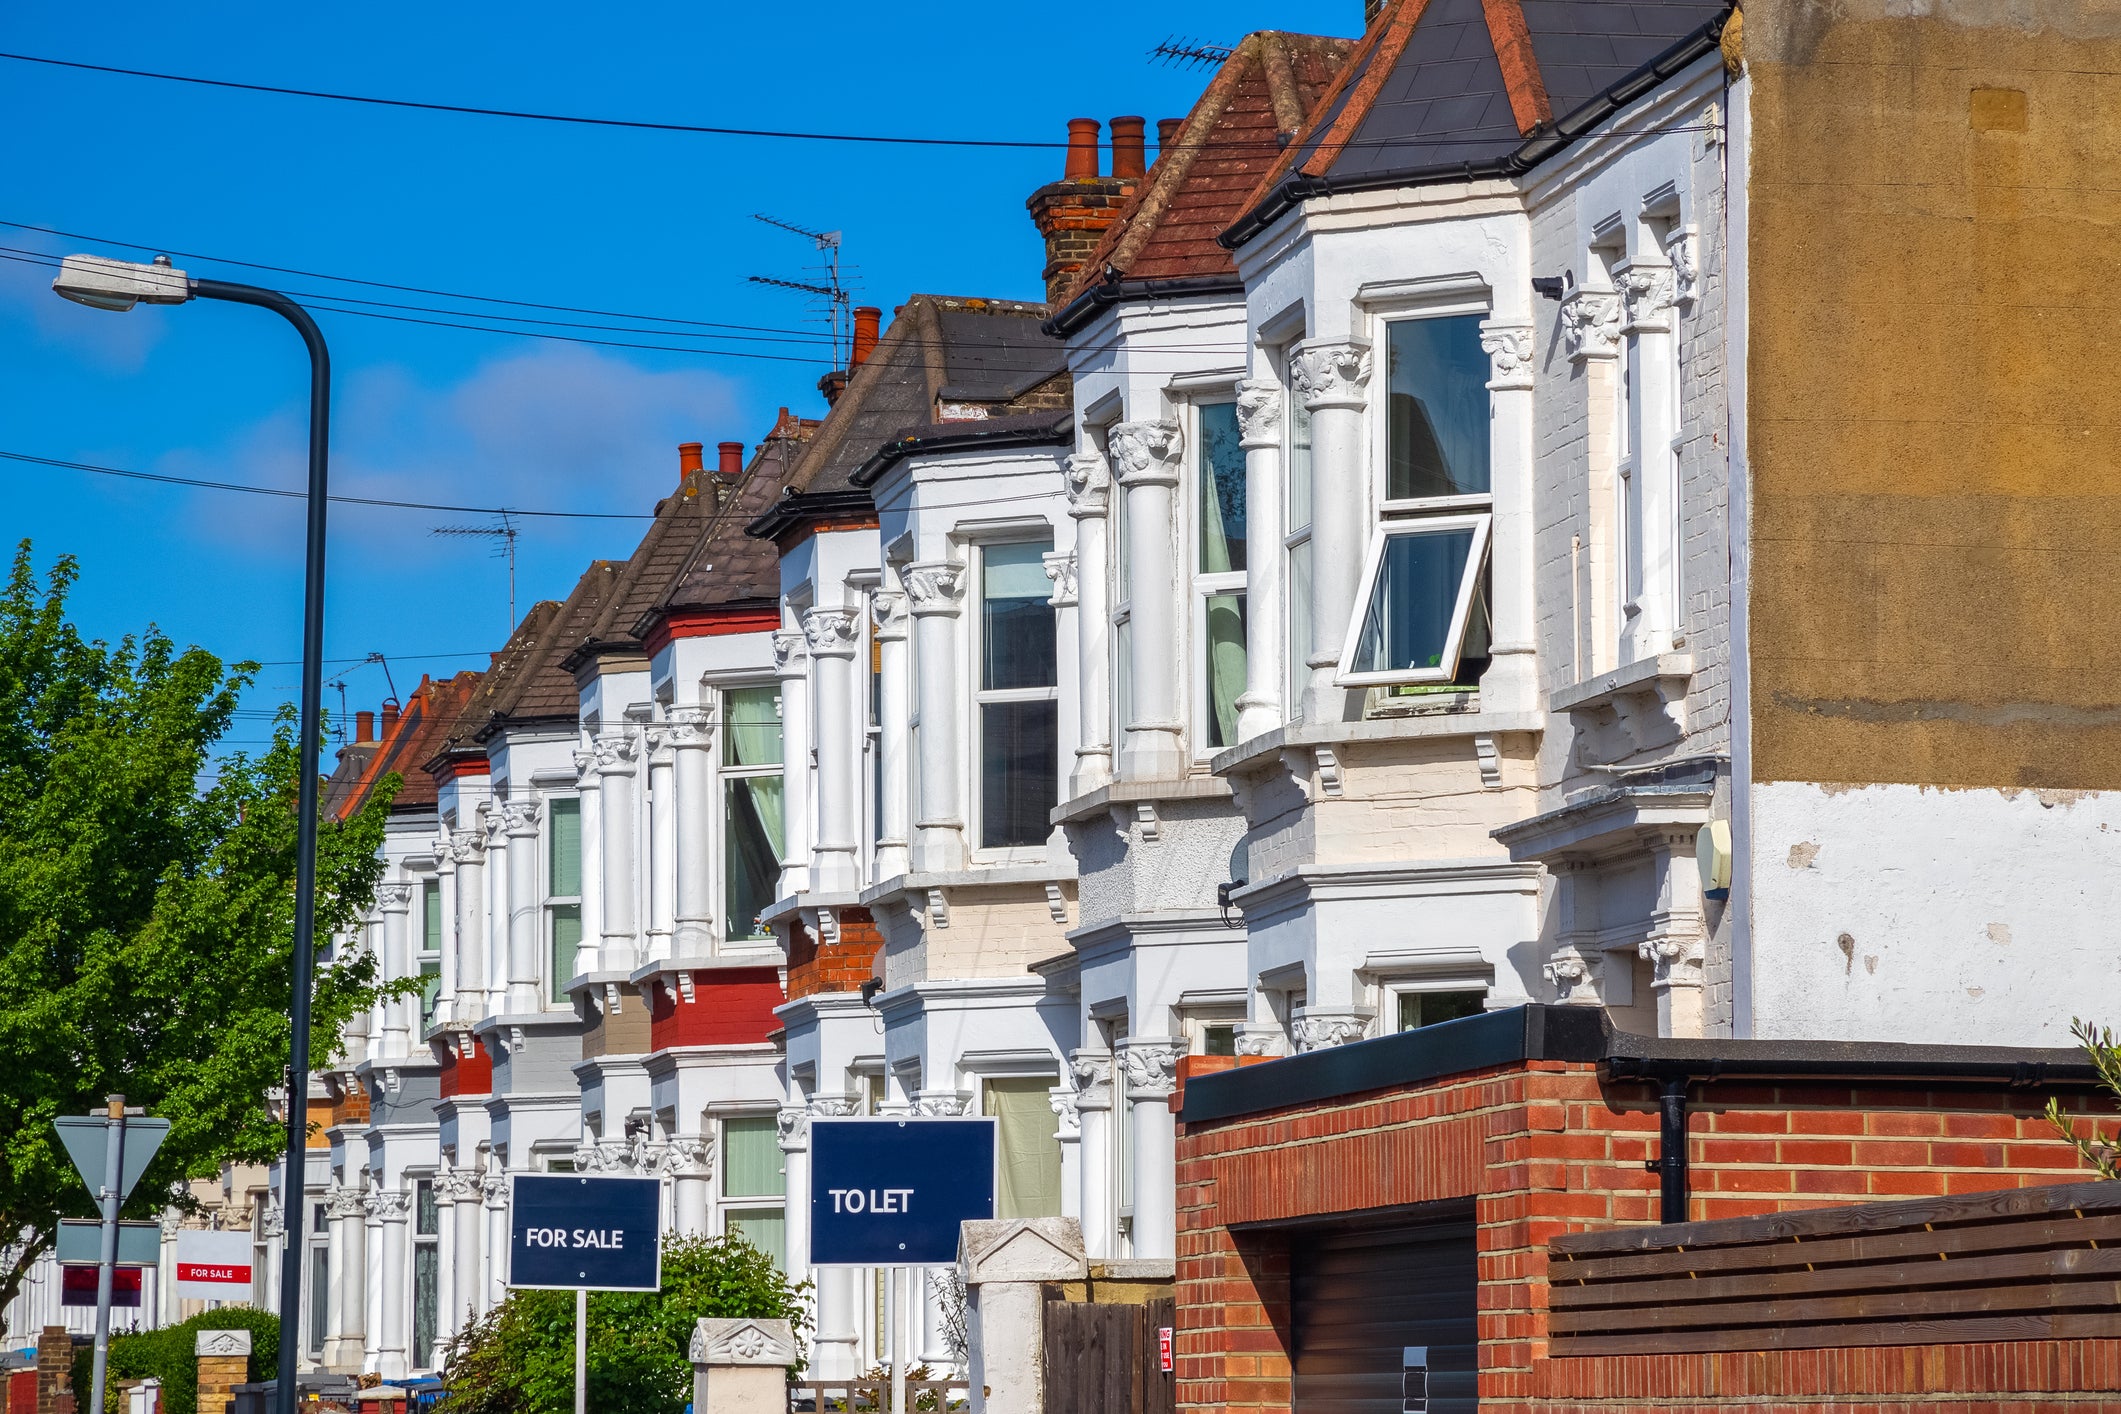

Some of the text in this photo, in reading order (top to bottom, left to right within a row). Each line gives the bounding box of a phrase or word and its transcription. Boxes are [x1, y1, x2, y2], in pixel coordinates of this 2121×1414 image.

[828, 1188, 915, 1213] TO LET
[526, 1228, 624, 1249] FOR SALE
[190, 1268, 233, 1279] FOR SALE
